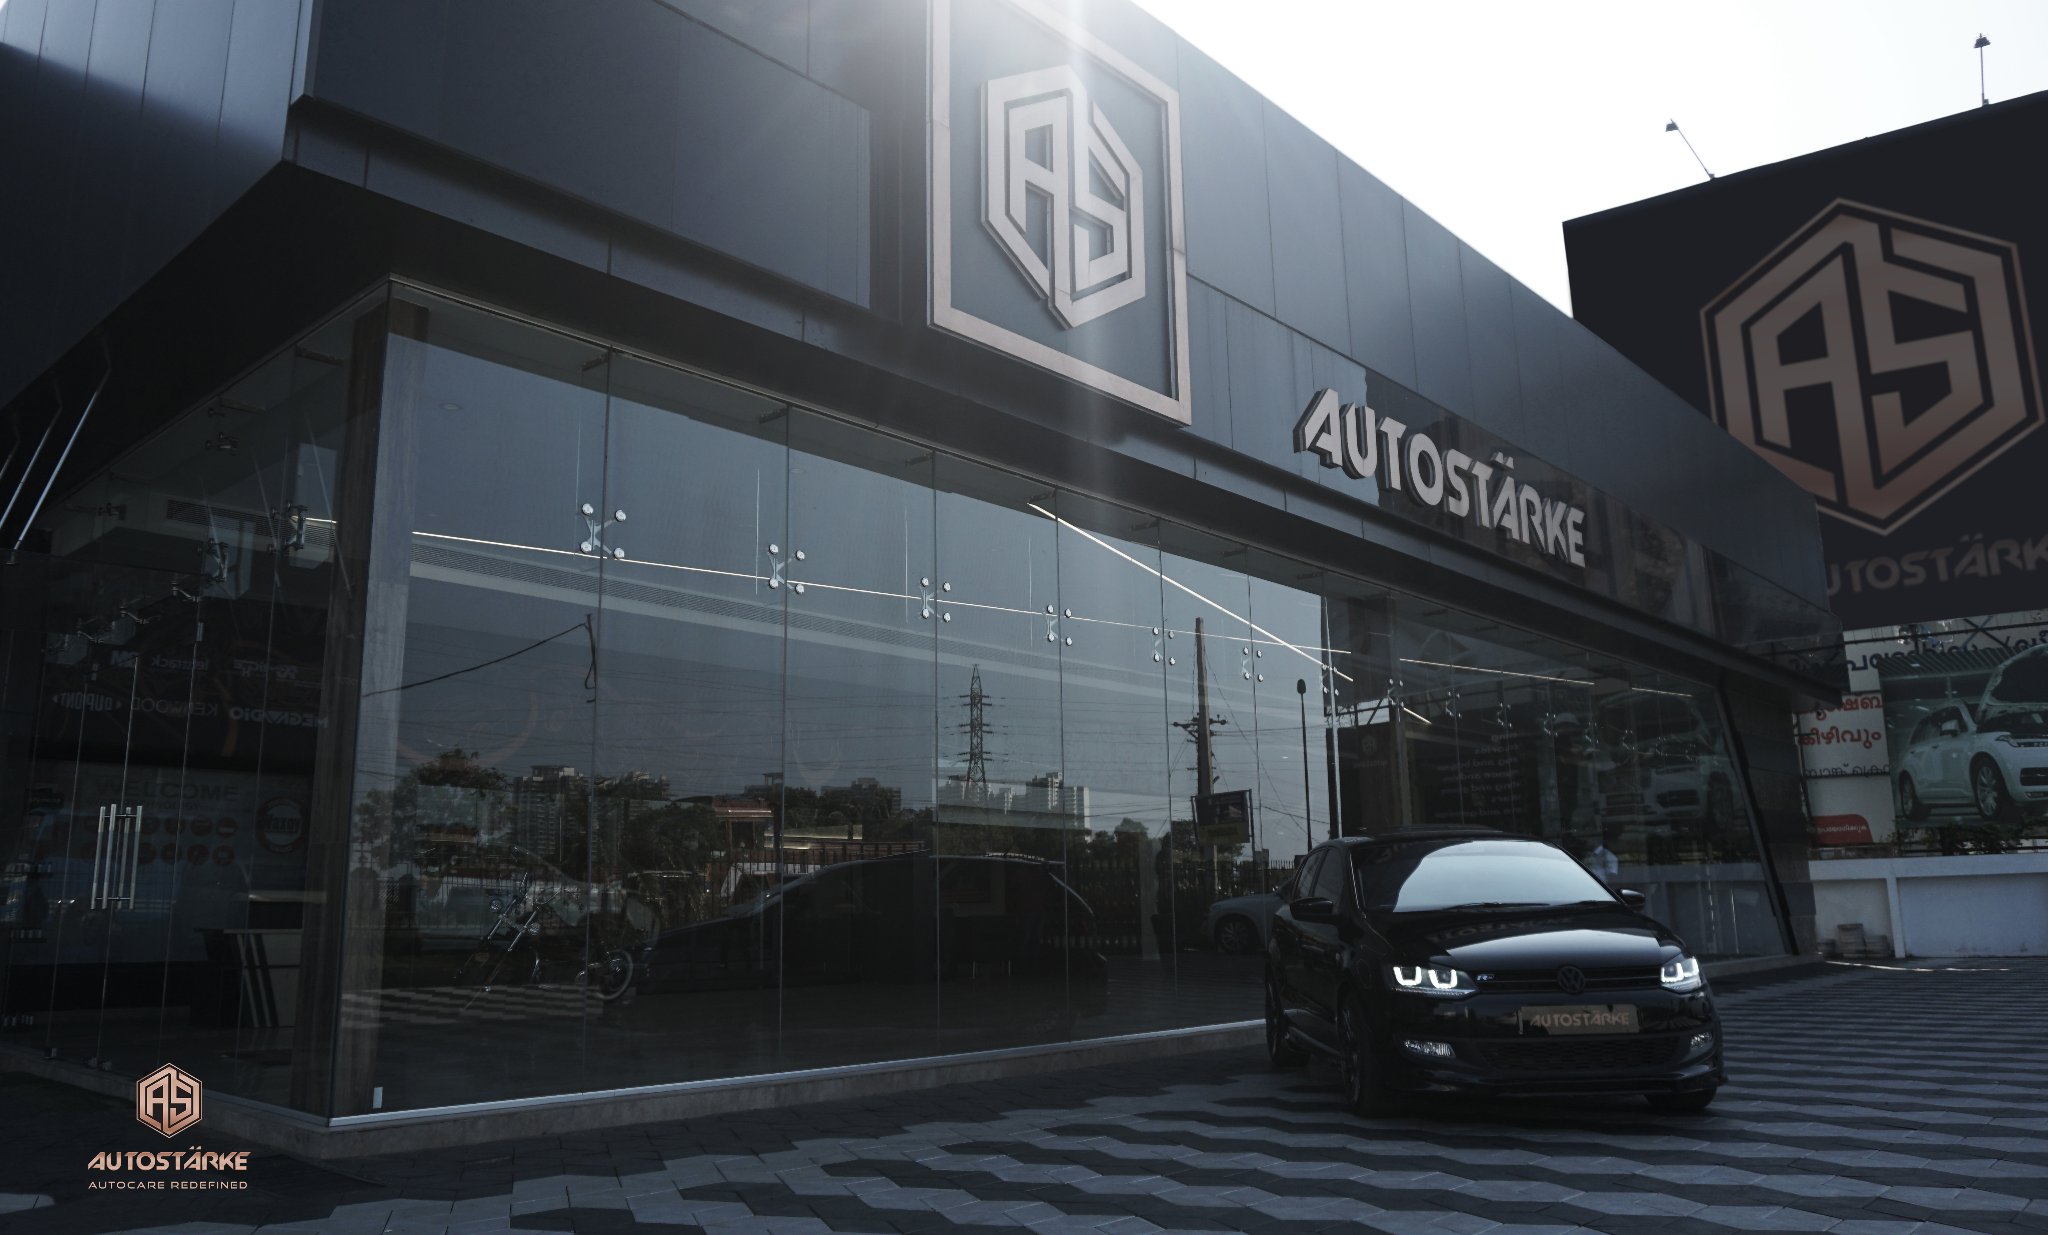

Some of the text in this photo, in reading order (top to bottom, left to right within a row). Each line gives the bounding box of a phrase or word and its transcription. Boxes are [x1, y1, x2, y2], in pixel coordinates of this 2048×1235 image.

[981, 64, 1145, 329] AS
[1702, 199, 2045, 535] AS
[1293, 388, 1586, 568] AUTOSTÄRKE
[97, 780, 241, 801] WELCOME
[1529, 1010, 1630, 1027] AUTOSTÄRKE
